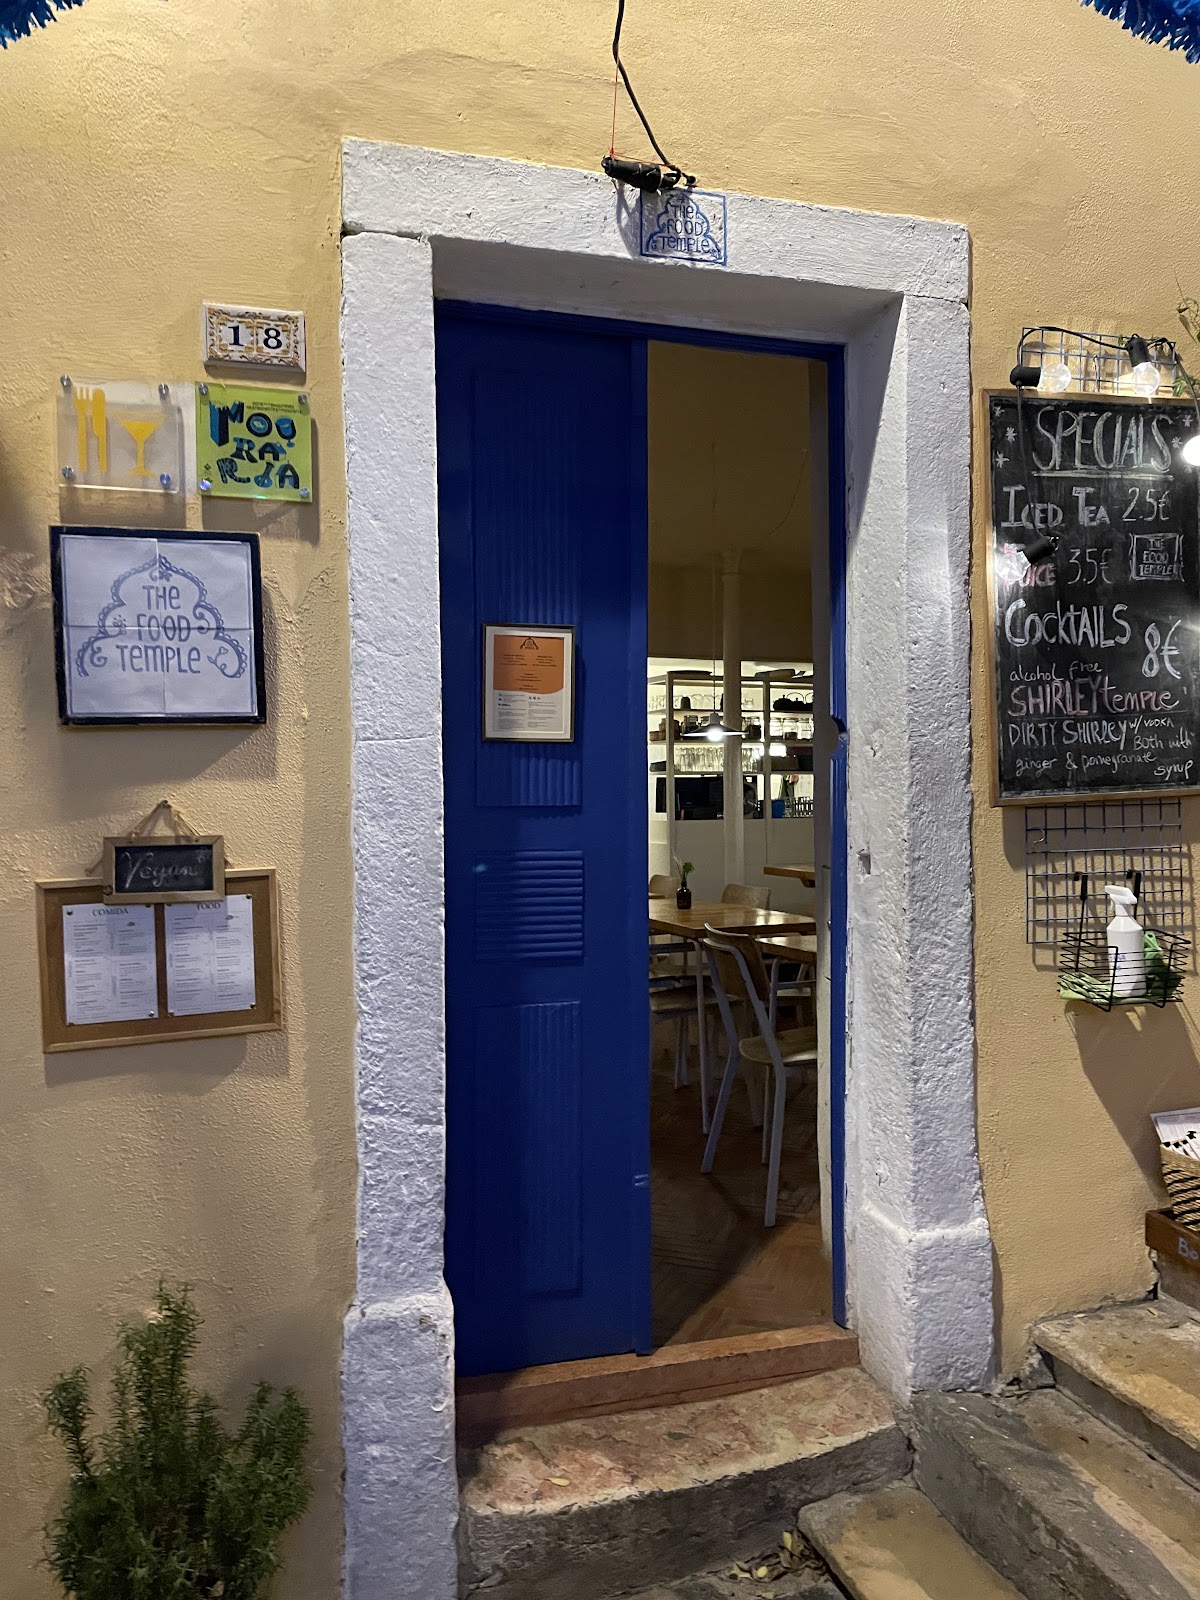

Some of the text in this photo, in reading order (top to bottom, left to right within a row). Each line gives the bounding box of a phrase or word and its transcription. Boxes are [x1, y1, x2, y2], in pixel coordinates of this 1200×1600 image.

[667, 219, 704, 236] FOOD
[227, 324, 283, 350] 18
[1032, 405, 1173, 474] SPECIALS
[1001, 485, 1170, 530] ICED TEA 2.5€
[1067, 548, 1113, 585] 3.5€
[1139, 564, 1174, 576] TEMPLE
[1143, 551, 1169, 563] FOOD
[136, 613, 191, 642] FOOD
[1141, 619, 1182, 680] 8€
[1009, 660, 1103, 682] alcohol free
[1007, 676, 1101, 717] SHIRLEY
[1008, 721, 1056, 747] DIRTY
[1015, 757, 1058, 777] ginger
[1065, 751, 1078, 769] &
[1154, 759, 1194, 781] syrup
[92, 908, 129, 917] COMIDA
